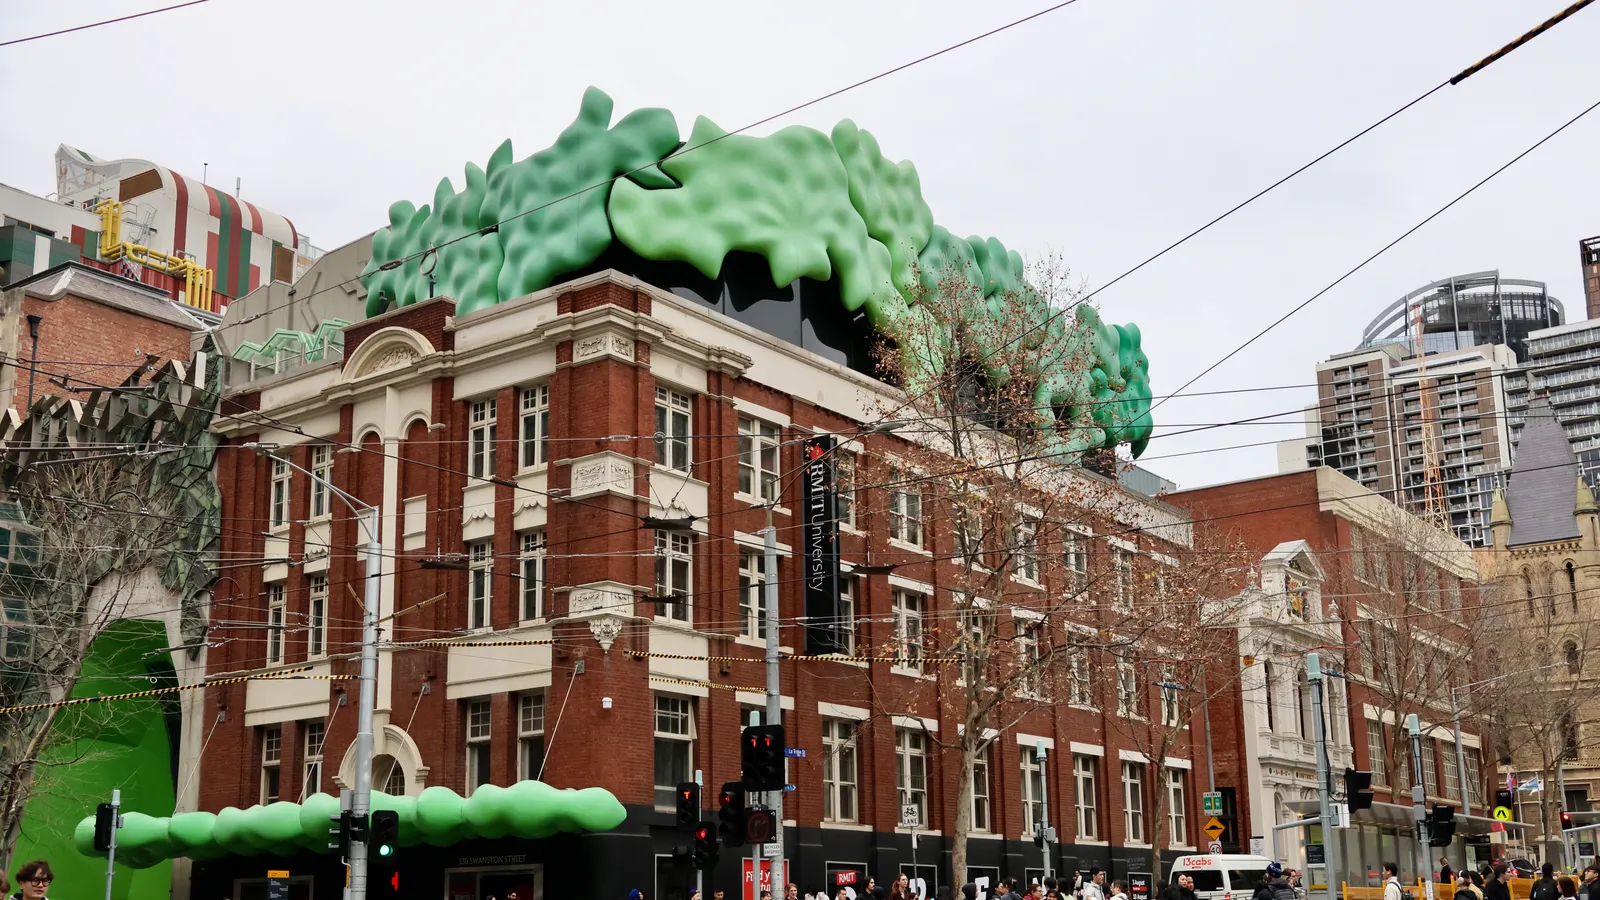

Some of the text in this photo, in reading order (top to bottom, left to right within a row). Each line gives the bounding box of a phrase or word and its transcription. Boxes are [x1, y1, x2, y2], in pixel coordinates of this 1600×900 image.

[808, 463, 826, 593] RMIT University
[1211, 846, 1220, 854] 40
[469, 855, 503, 864] SWANSTON
[504, 855, 526, 863] STREET
[1183, 857, 1212, 866] 13cabs
[745, 870, 763, 882] Fid
[838, 872, 855, 883] RMIT
